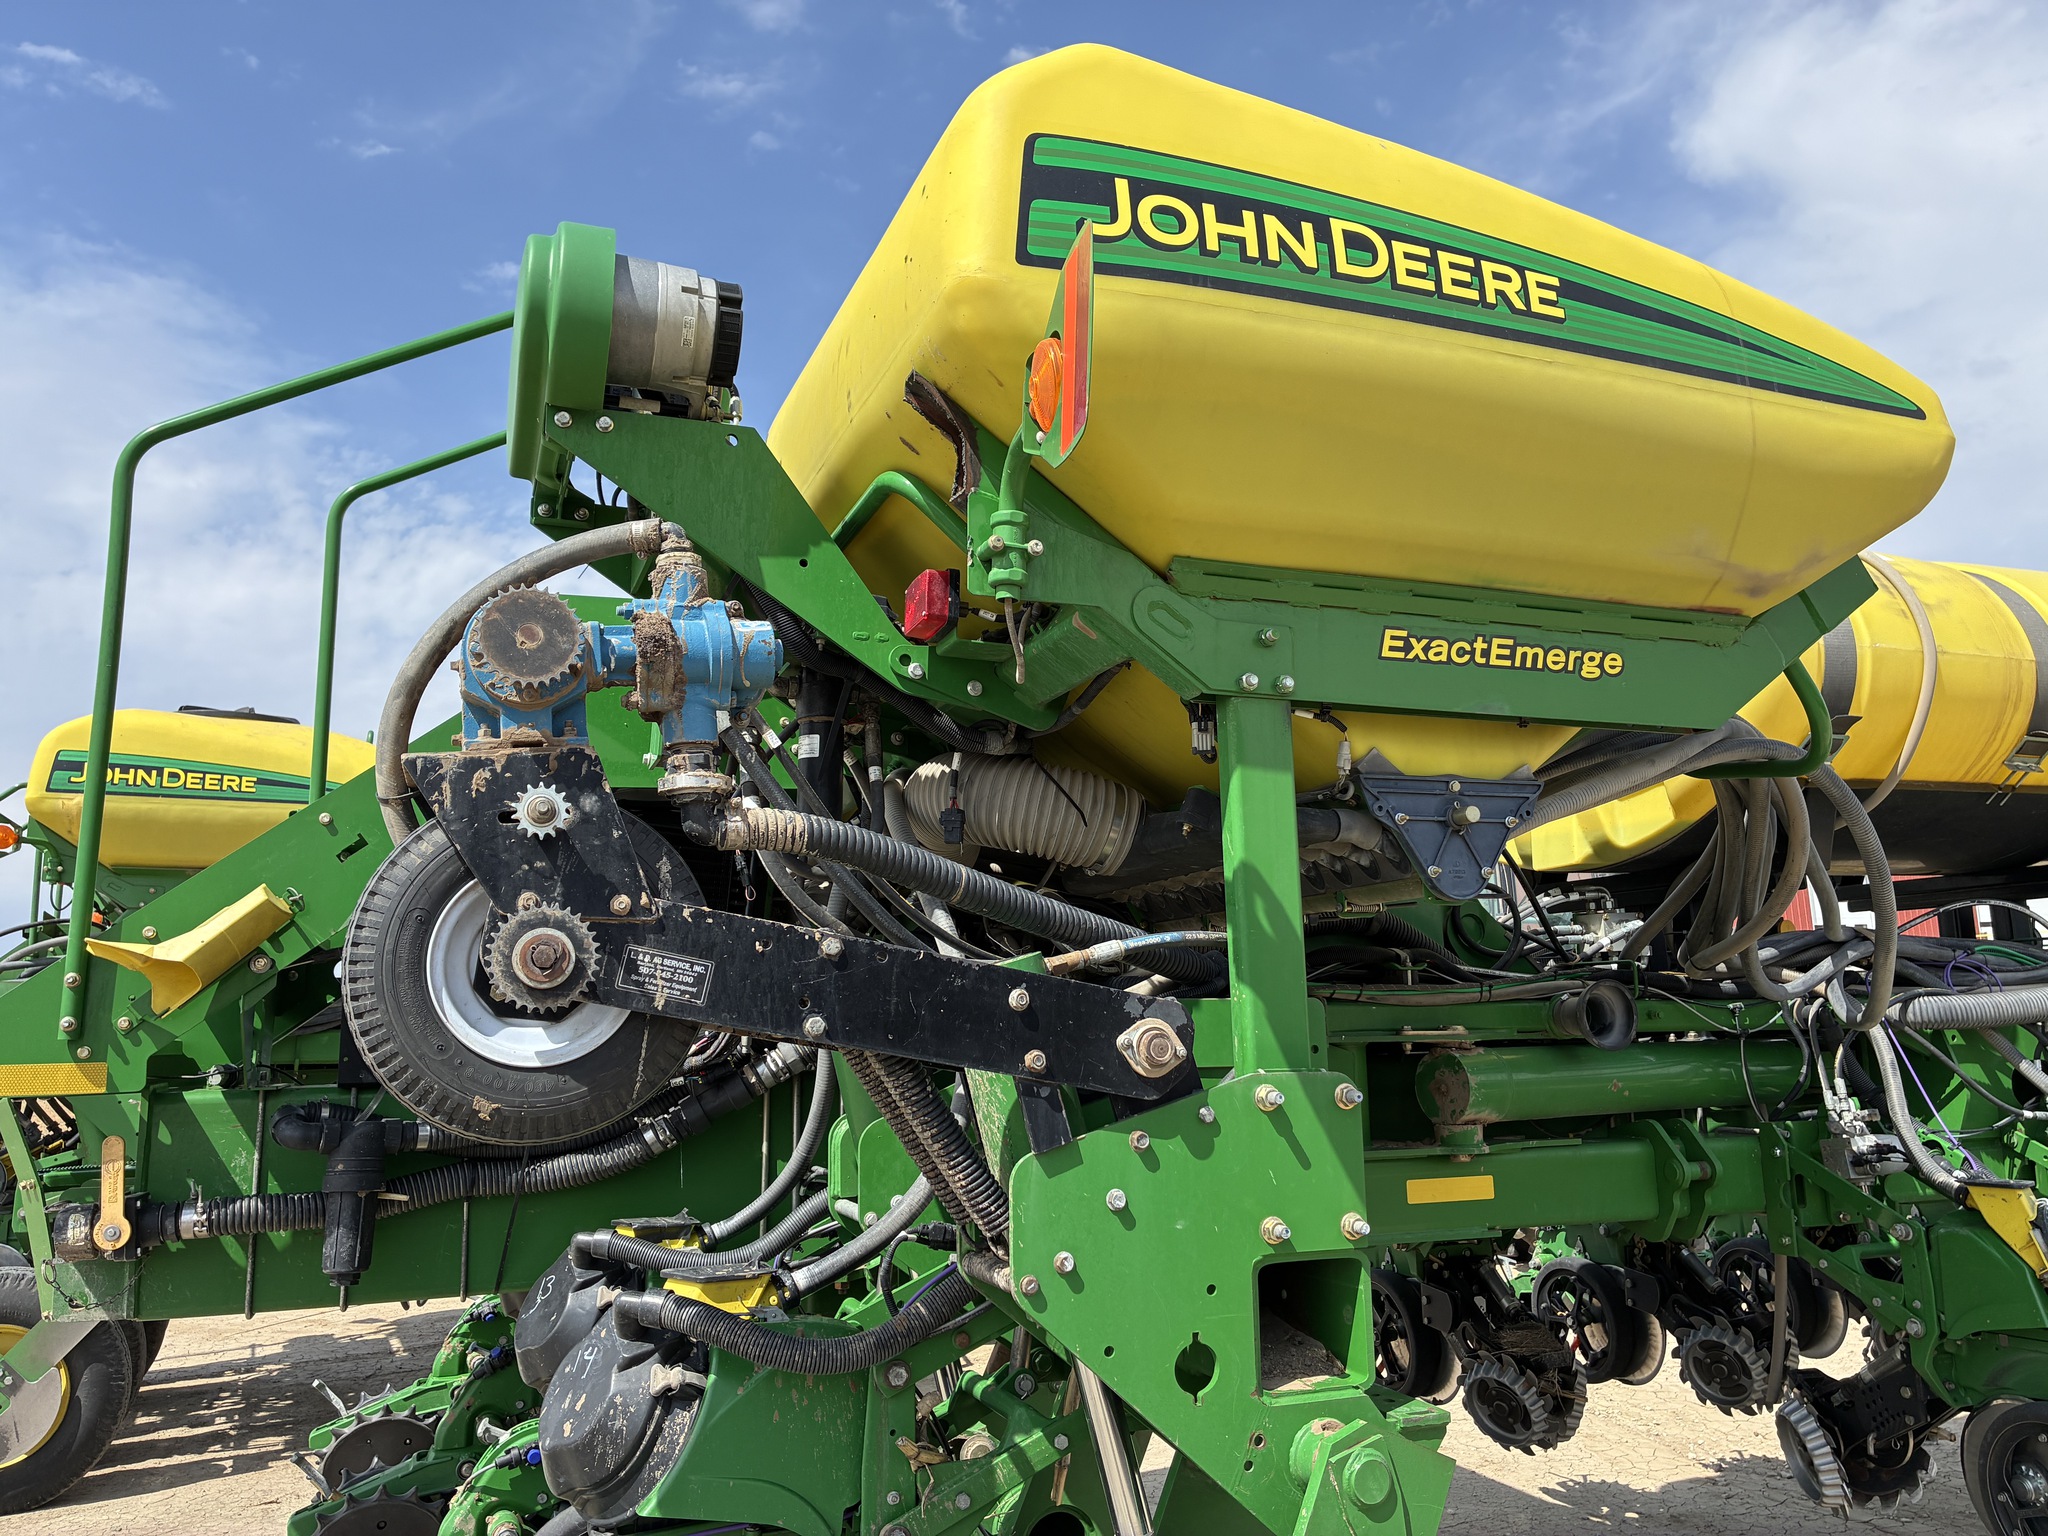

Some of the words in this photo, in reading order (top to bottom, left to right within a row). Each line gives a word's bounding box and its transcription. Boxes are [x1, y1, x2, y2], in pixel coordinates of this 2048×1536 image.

[1092, 177, 1320, 271] JOHN
[1328, 217, 1567, 320] DEERE
[1380, 628, 1624, 679] ExactEmerge
[70, 761, 158, 788] JHN
[162, 767, 258, 793] DEERE
[663, 958, 692, 971] SERVICE,
[692, 964, 706, 974] INC.
[572, 1346, 598, 1380] 14
